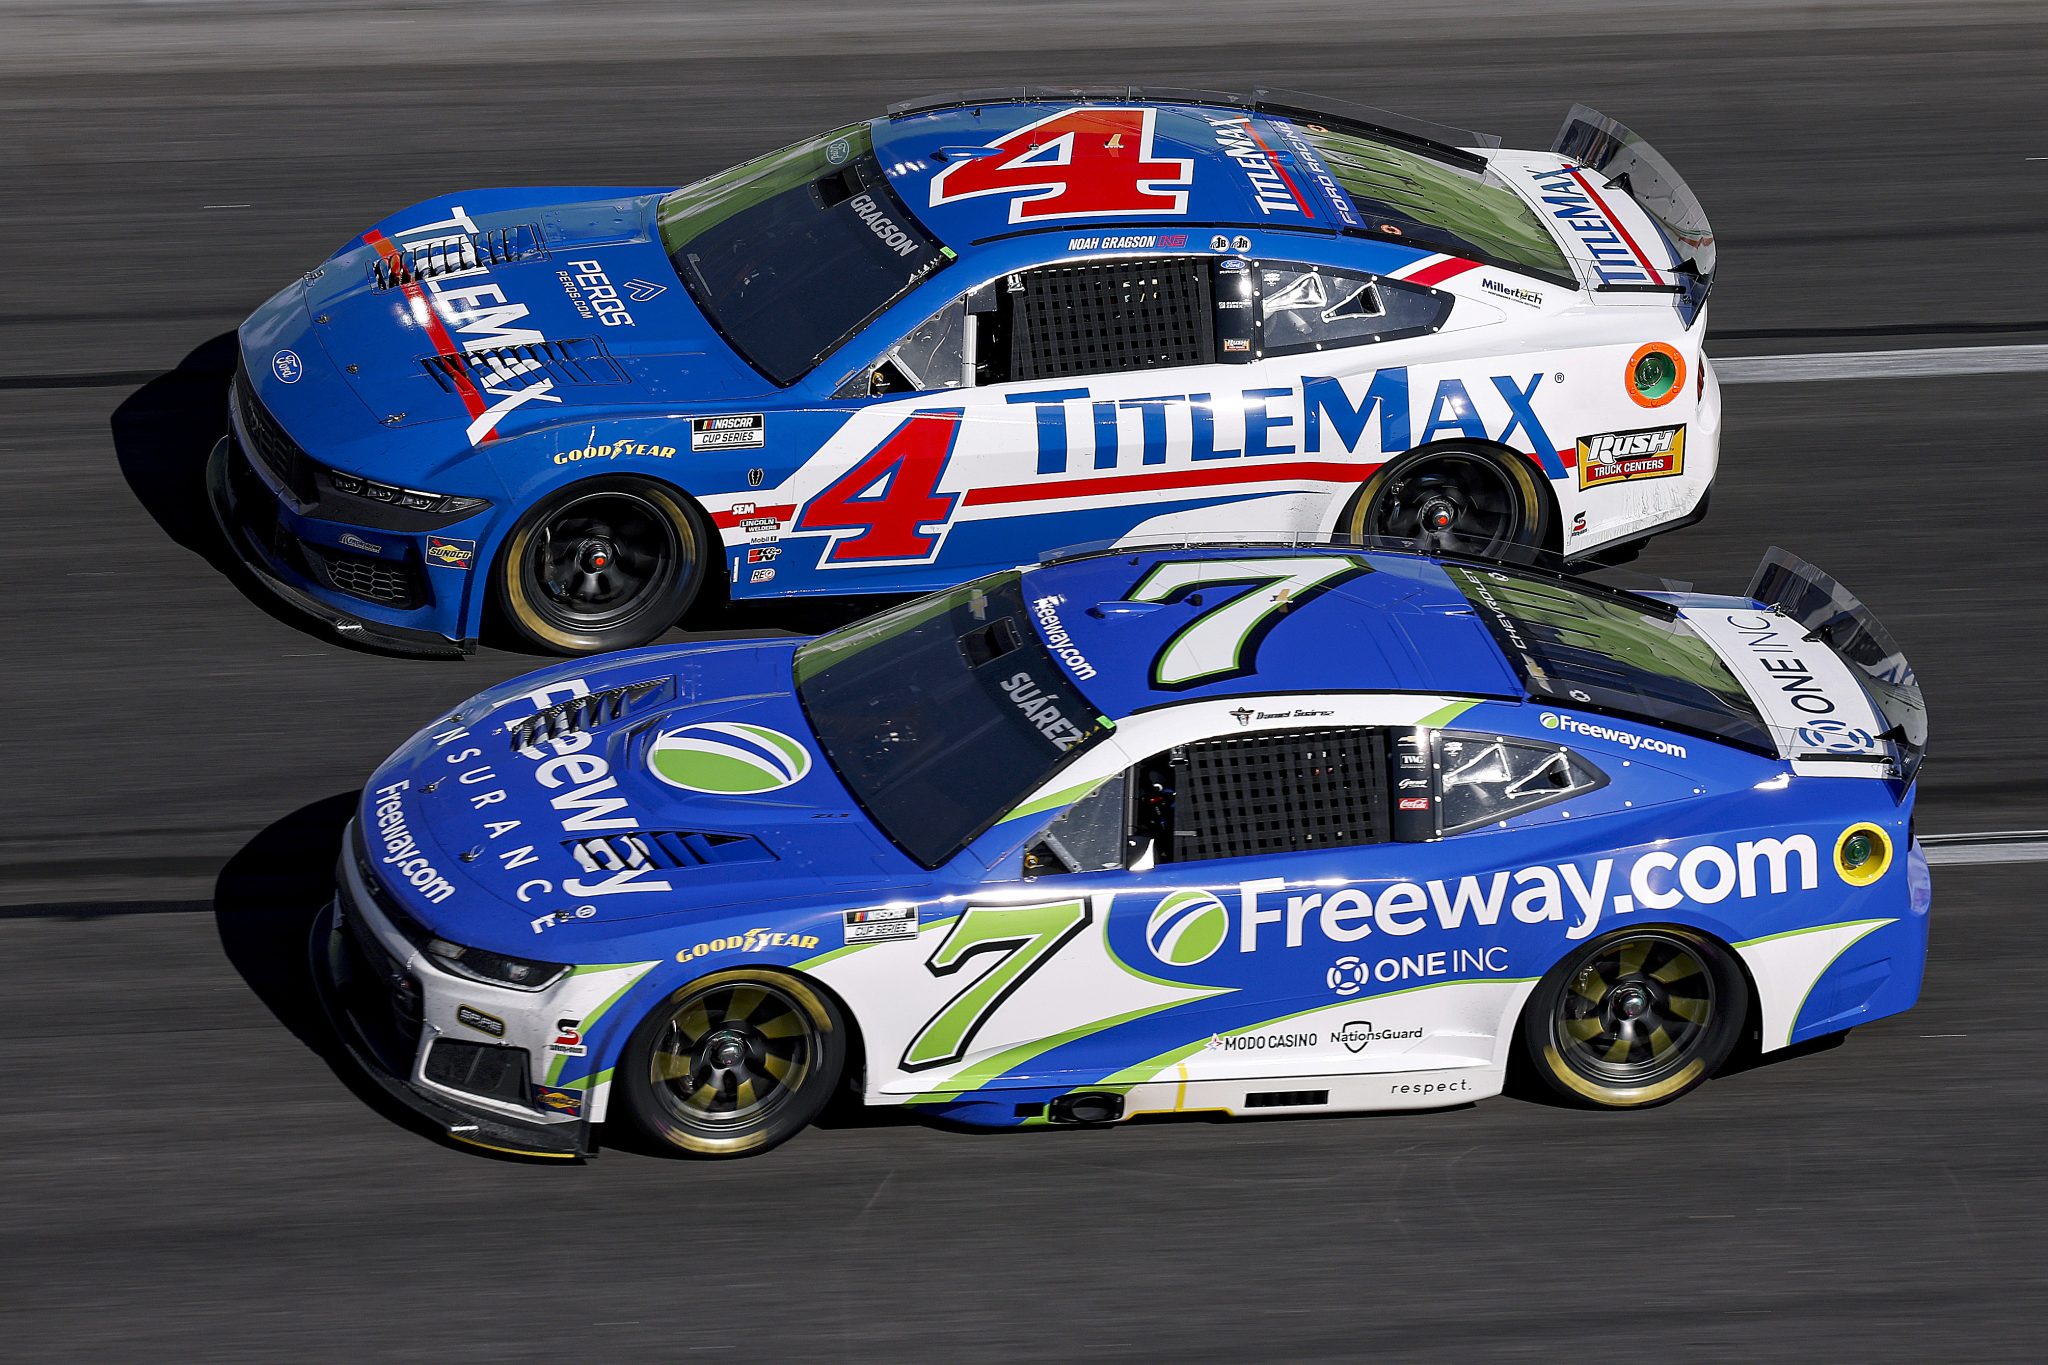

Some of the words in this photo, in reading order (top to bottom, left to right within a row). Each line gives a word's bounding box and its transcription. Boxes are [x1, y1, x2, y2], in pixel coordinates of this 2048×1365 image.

[929, 106, 1194, 225] 4
[1204, 117, 1300, 215] TITLEMAX
[1273, 120, 1326, 174] RACING
[1318, 174, 1358, 225] FORD
[850, 194, 919, 257] GRAGSON
[1068, 237, 1100, 251] NOAH
[1101, 235, 1157, 249] GRAGSON
[1527, 165, 1648, 285] TITLEMAX
[555, 270, 594, 319] PERQS.COM
[567, 260, 635, 327] PERQS
[1481, 277, 1543, 305] Millertech
[275, 353, 298, 379] Ford
[702, 431, 721, 444] CUP
[721, 430, 754, 443] SERIES
[712, 416, 754, 430] NASCAR
[1004, 366, 1569, 480] TITLEMAX
[553, 440, 677, 465] GOODYEAR
[1587, 429, 1676, 465] RUSH
[791, 407, 965, 567] 4
[1594, 463, 1623, 478] TRUCK
[1623, 459, 1664, 474] CENTERS
[732, 503, 755, 515] SEM
[741, 518, 775, 527] LINCOLN
[428, 546, 472, 560] SUNOCO
[750, 536, 770, 544] Mobil
[1124, 555, 1374, 690] 7
[1459, 567, 1528, 650] CHEVROLET
[1033, 594, 1098, 682] Freeway.com
[1726, 615, 1794, 653] INC
[1759, 657, 1836, 714] ONE
[1000, 672, 1084, 751] SUÁREZ
[1559, 714, 1688, 760] Freeway.com
[375, 779, 456, 905] Freeway.com
[1238, 832, 1819, 954] Freeway.com
[675, 927, 820, 963] GOODYEAR
[855, 925, 874, 937] CUP
[898, 896, 1093, 1074] 7
[1373, 952, 1447, 984] ONE
[1452, 946, 1509, 976] INC
[1224, 1035, 1267, 1051] MODO
[1267, 1032, 1318, 1049] CASINO
[1330, 1026, 1424, 1044] NationsGuard
[1391, 1079, 1472, 1096] respect.
